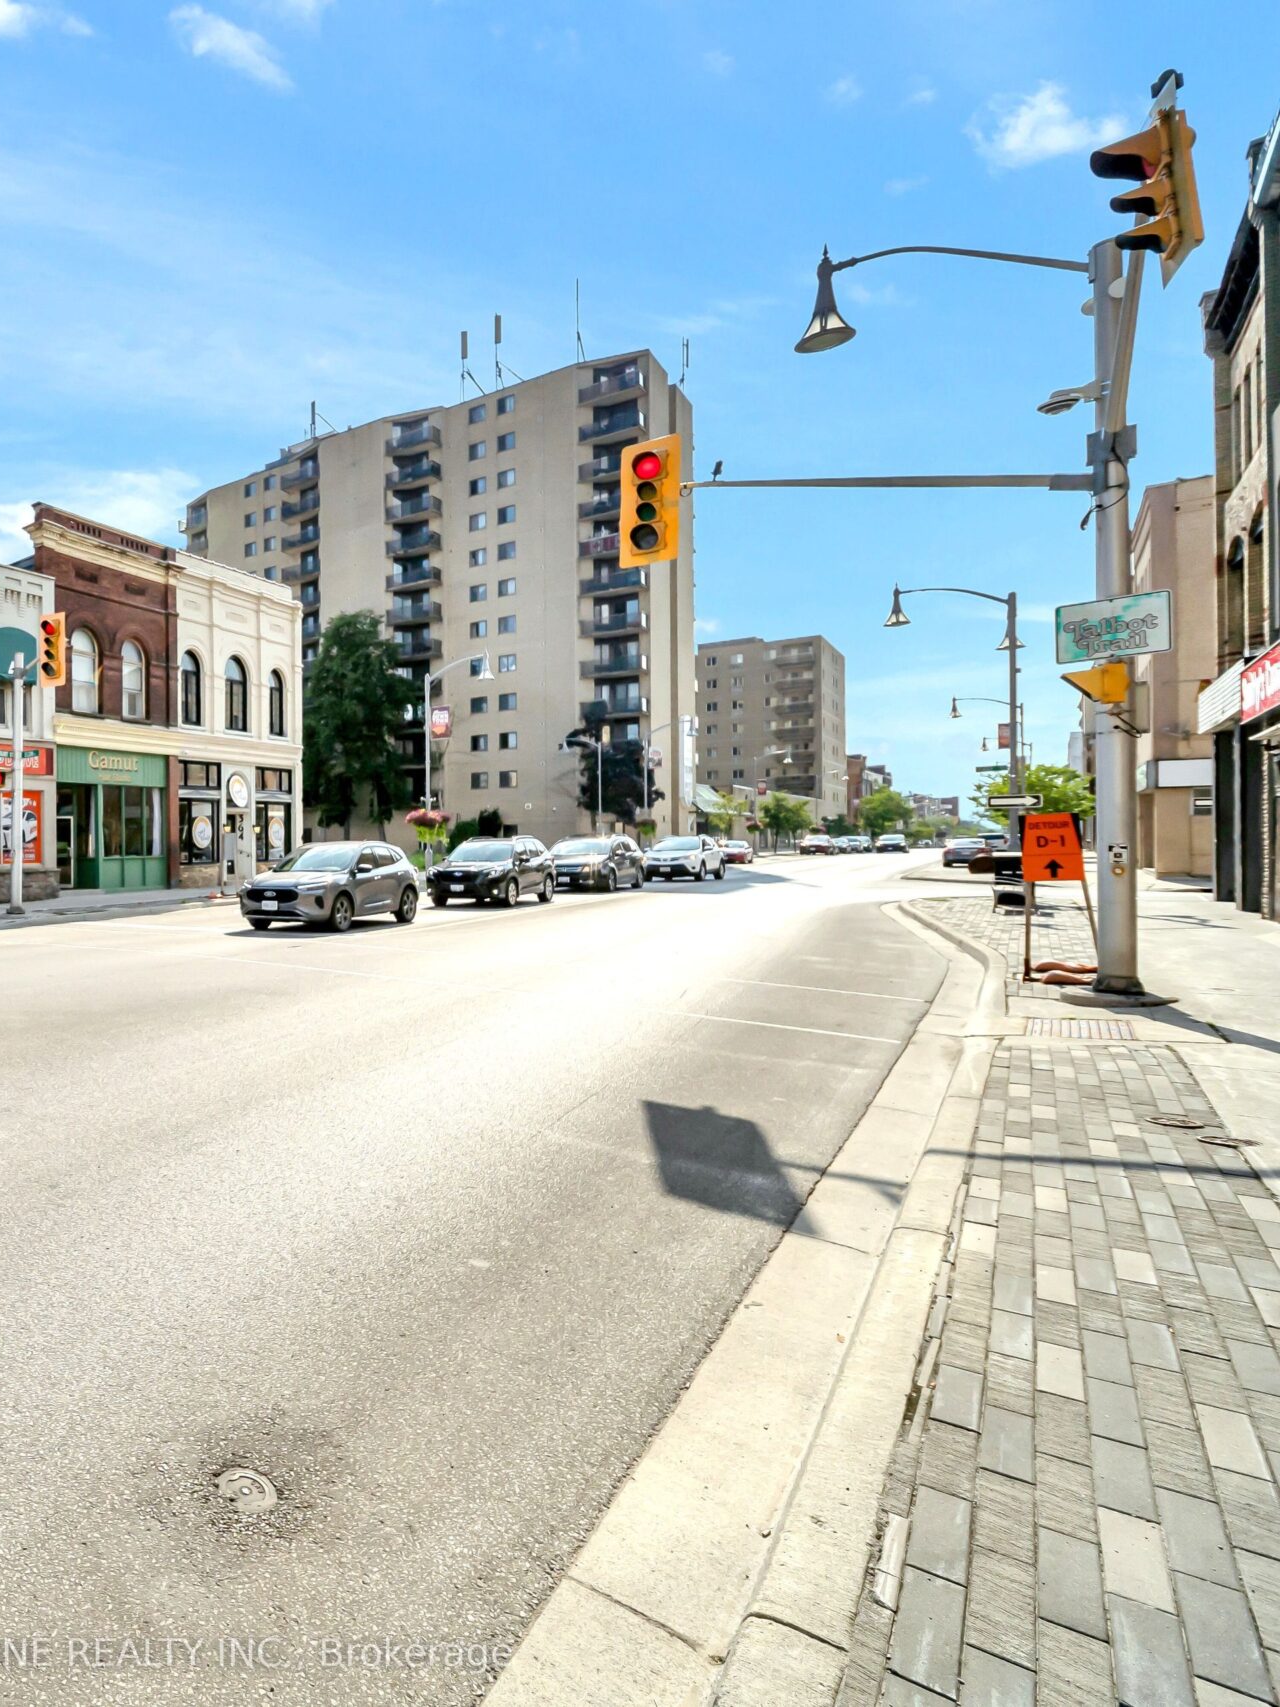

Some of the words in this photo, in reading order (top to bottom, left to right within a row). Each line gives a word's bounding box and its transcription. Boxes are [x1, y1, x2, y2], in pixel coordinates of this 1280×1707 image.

[1063, 613, 1159, 642] Talbot
[1077, 630, 1149, 657] Trail
[89, 751, 138, 770] Gamut
[1028, 821, 1069, 830] DETOUR
